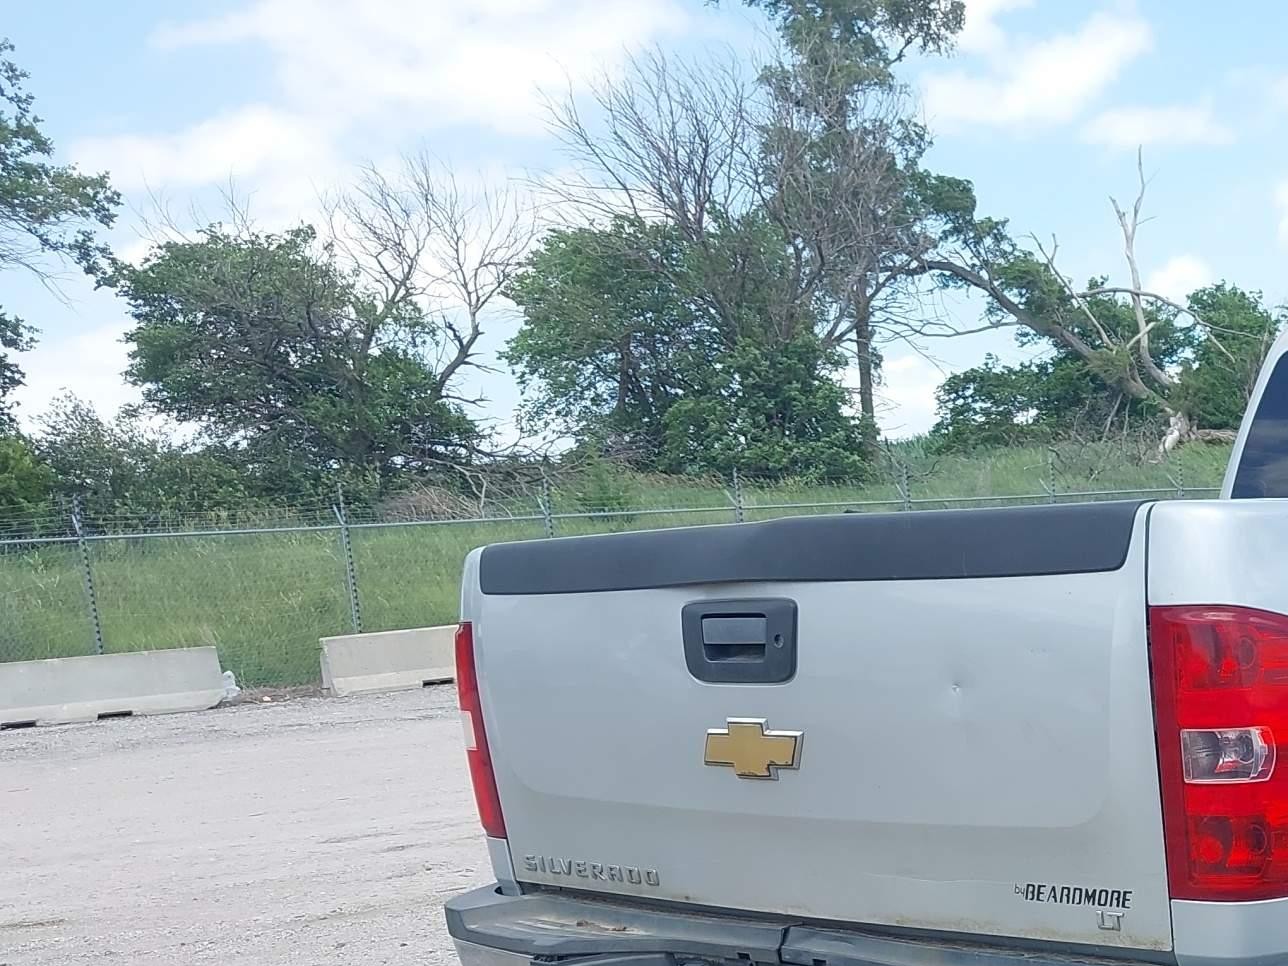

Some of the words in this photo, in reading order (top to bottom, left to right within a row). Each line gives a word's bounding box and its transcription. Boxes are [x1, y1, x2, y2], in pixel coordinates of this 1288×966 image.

[524, 854, 660, 887] SILVERADO
[1025, 883, 1133, 909] BEARDMORE
[1096, 910, 1124, 932] LT
